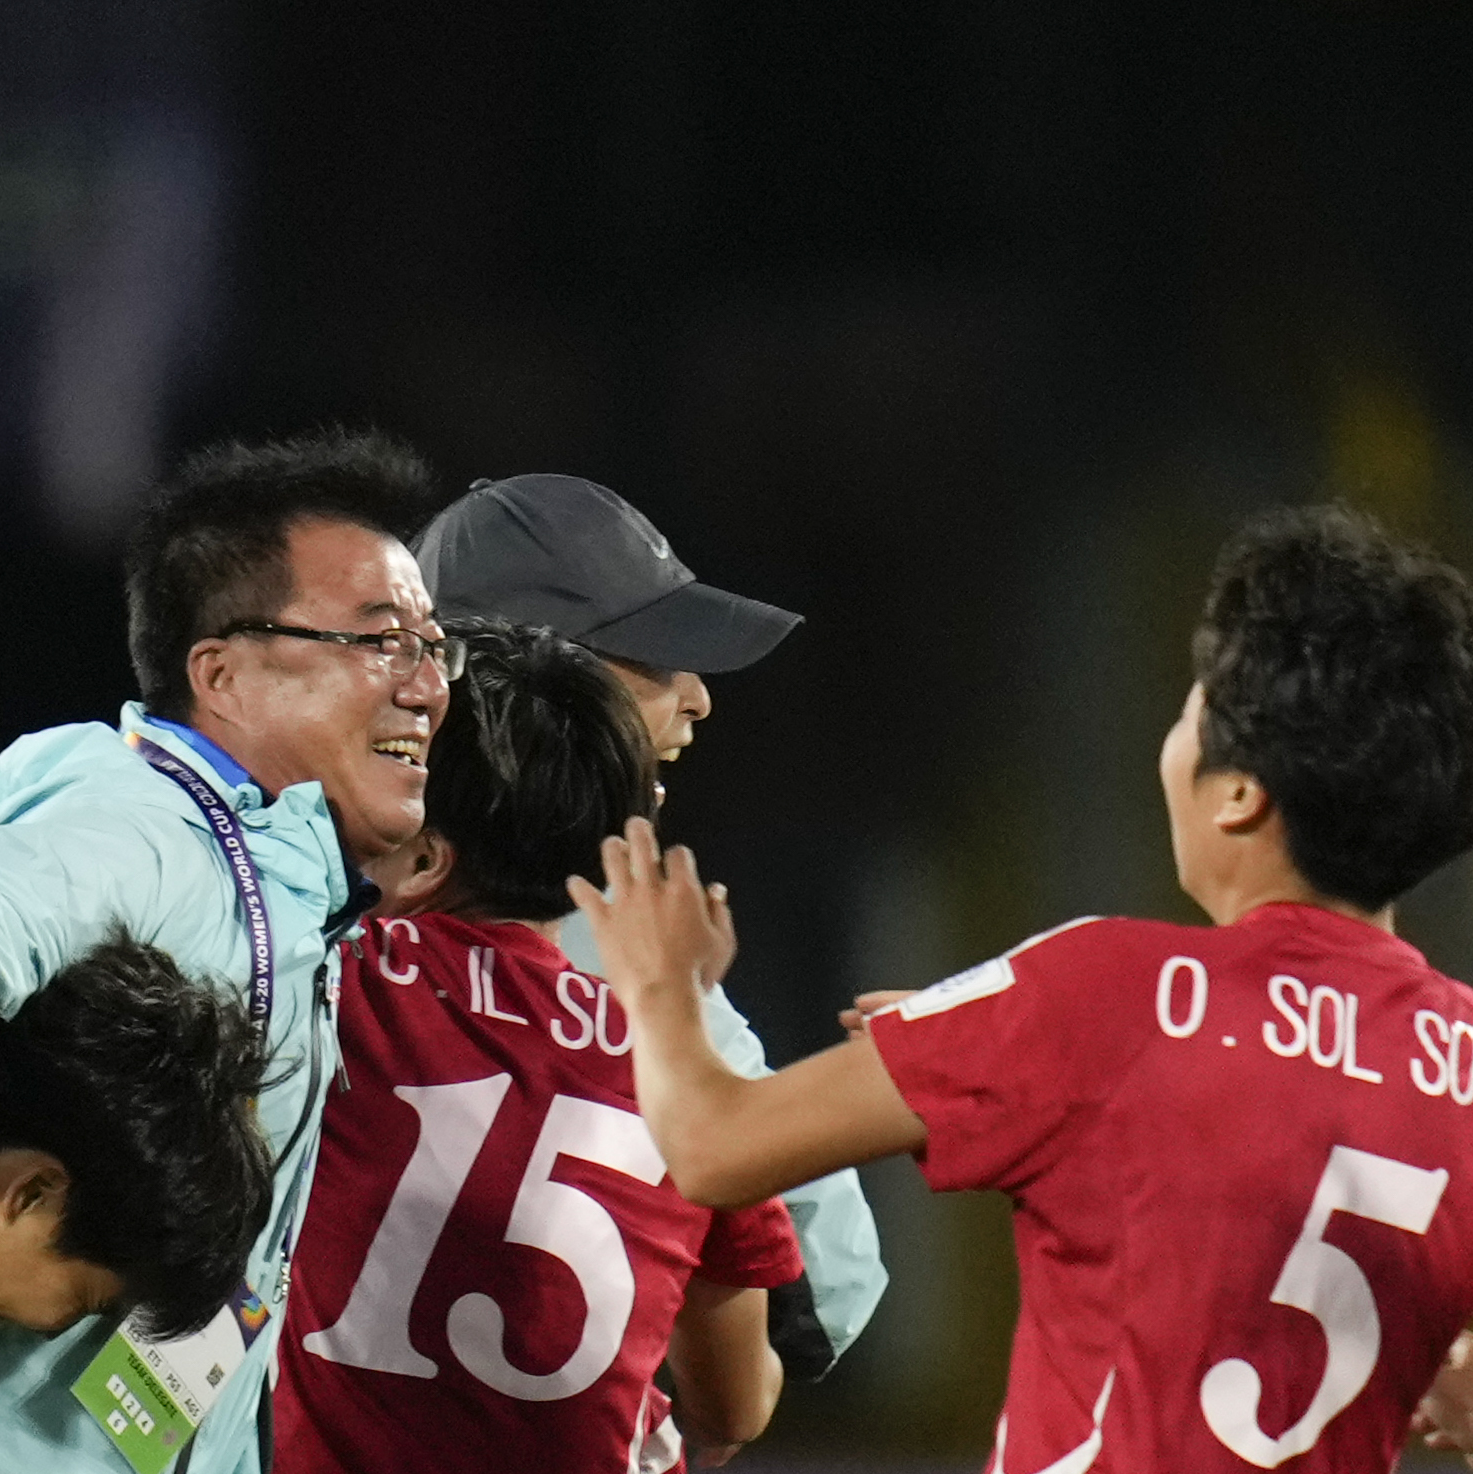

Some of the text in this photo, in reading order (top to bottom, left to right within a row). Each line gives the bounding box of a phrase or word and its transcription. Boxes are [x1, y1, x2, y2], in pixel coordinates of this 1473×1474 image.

[209, 807, 234, 834] CUP
[225, 837, 256, 893] WORLD
[246, 894, 269, 974] WOMEN'S
[254, 977, 269, 1014] U-20
[468, 945, 530, 1026] IL
[550, 971, 634, 1057] SO
[1262, 974, 1384, 1084] SOL
[303, 1072, 668, 1401] 15
[1200, 1144, 1450, 1469] 5
